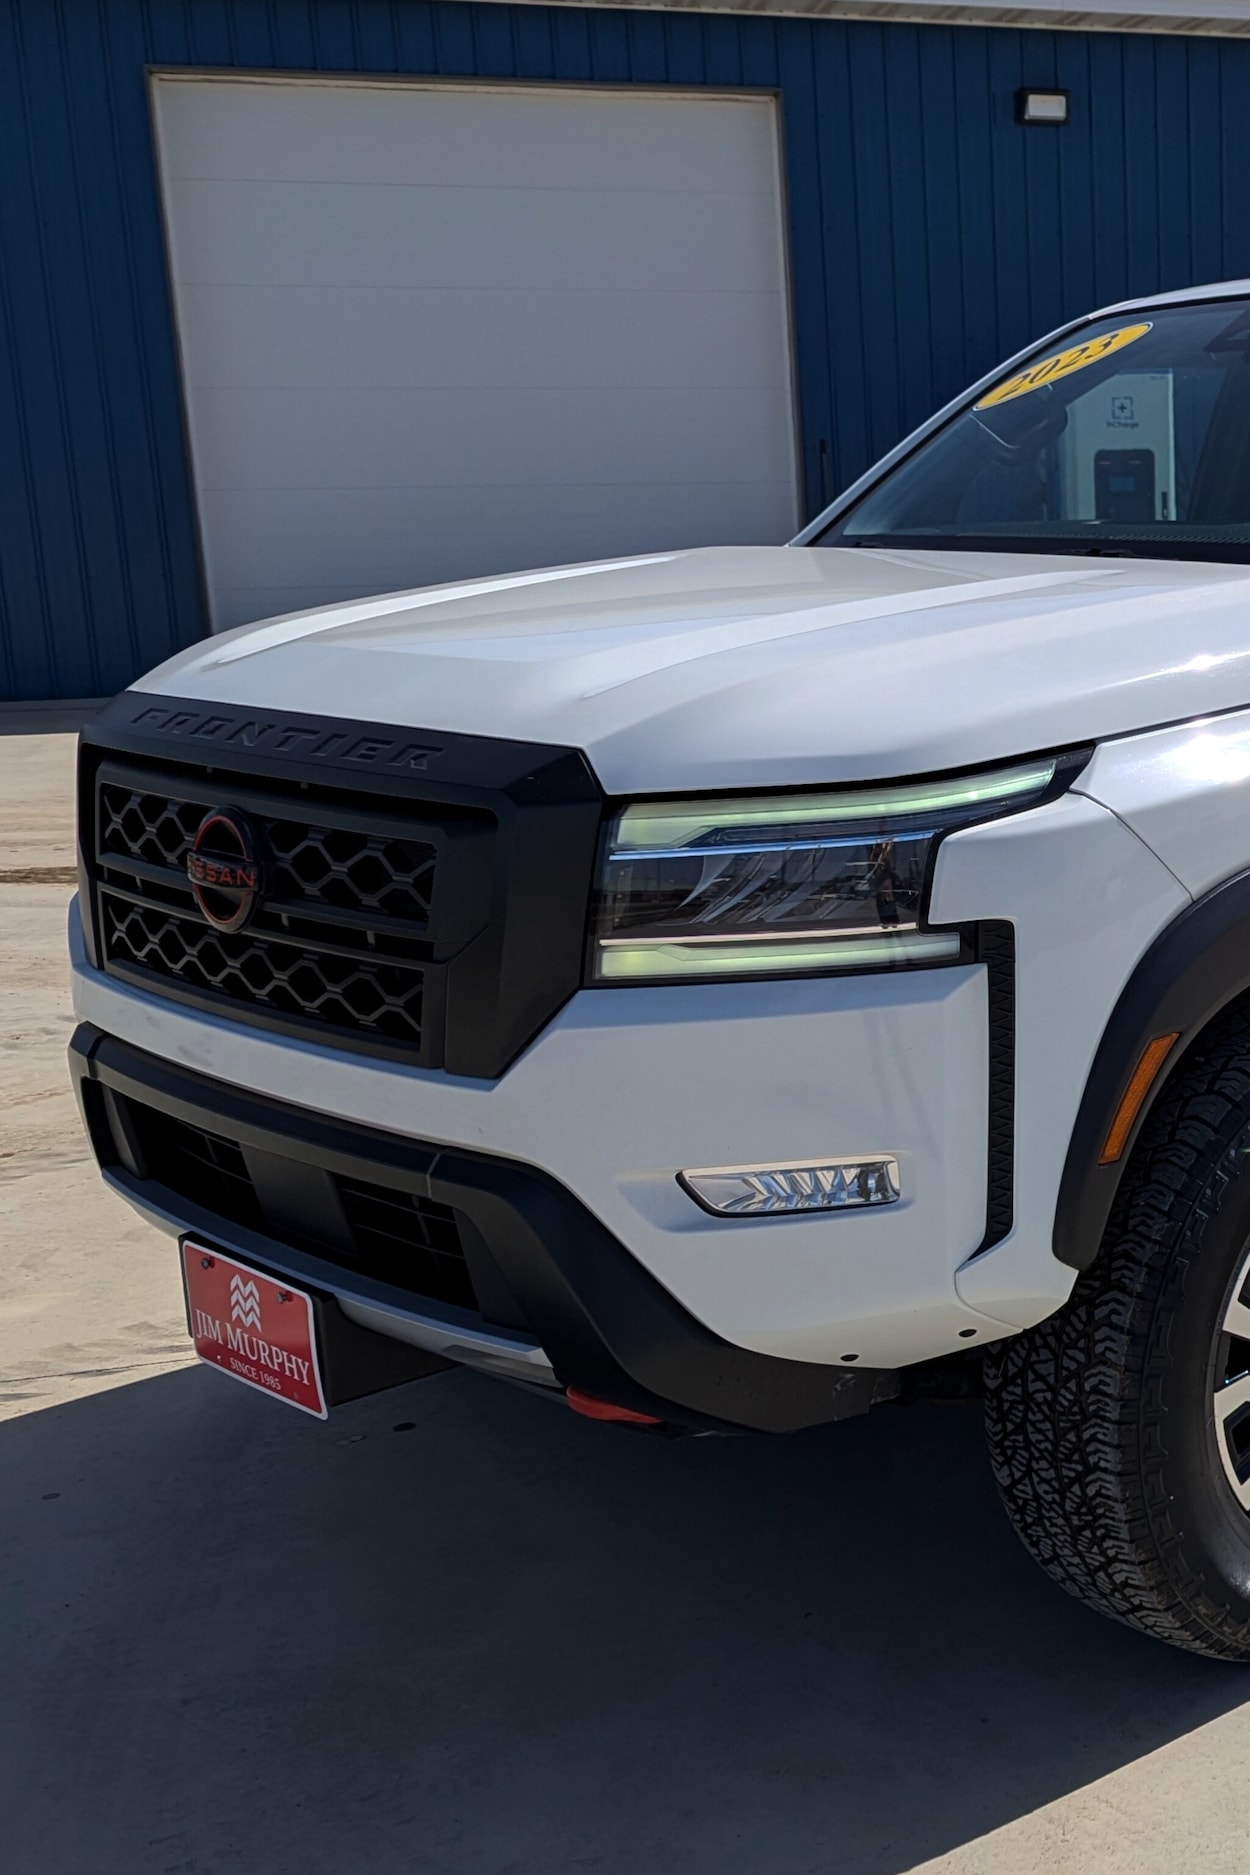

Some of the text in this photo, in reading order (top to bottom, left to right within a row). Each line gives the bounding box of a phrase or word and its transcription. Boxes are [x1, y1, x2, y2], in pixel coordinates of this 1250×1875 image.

[999, 333, 1120, 399] 2023
[131, 707, 445, 770] FRONTIER
[196, 1309, 310, 1385] JIM MURPHY
[230, 1358, 281, 1390] SINCE 1985
